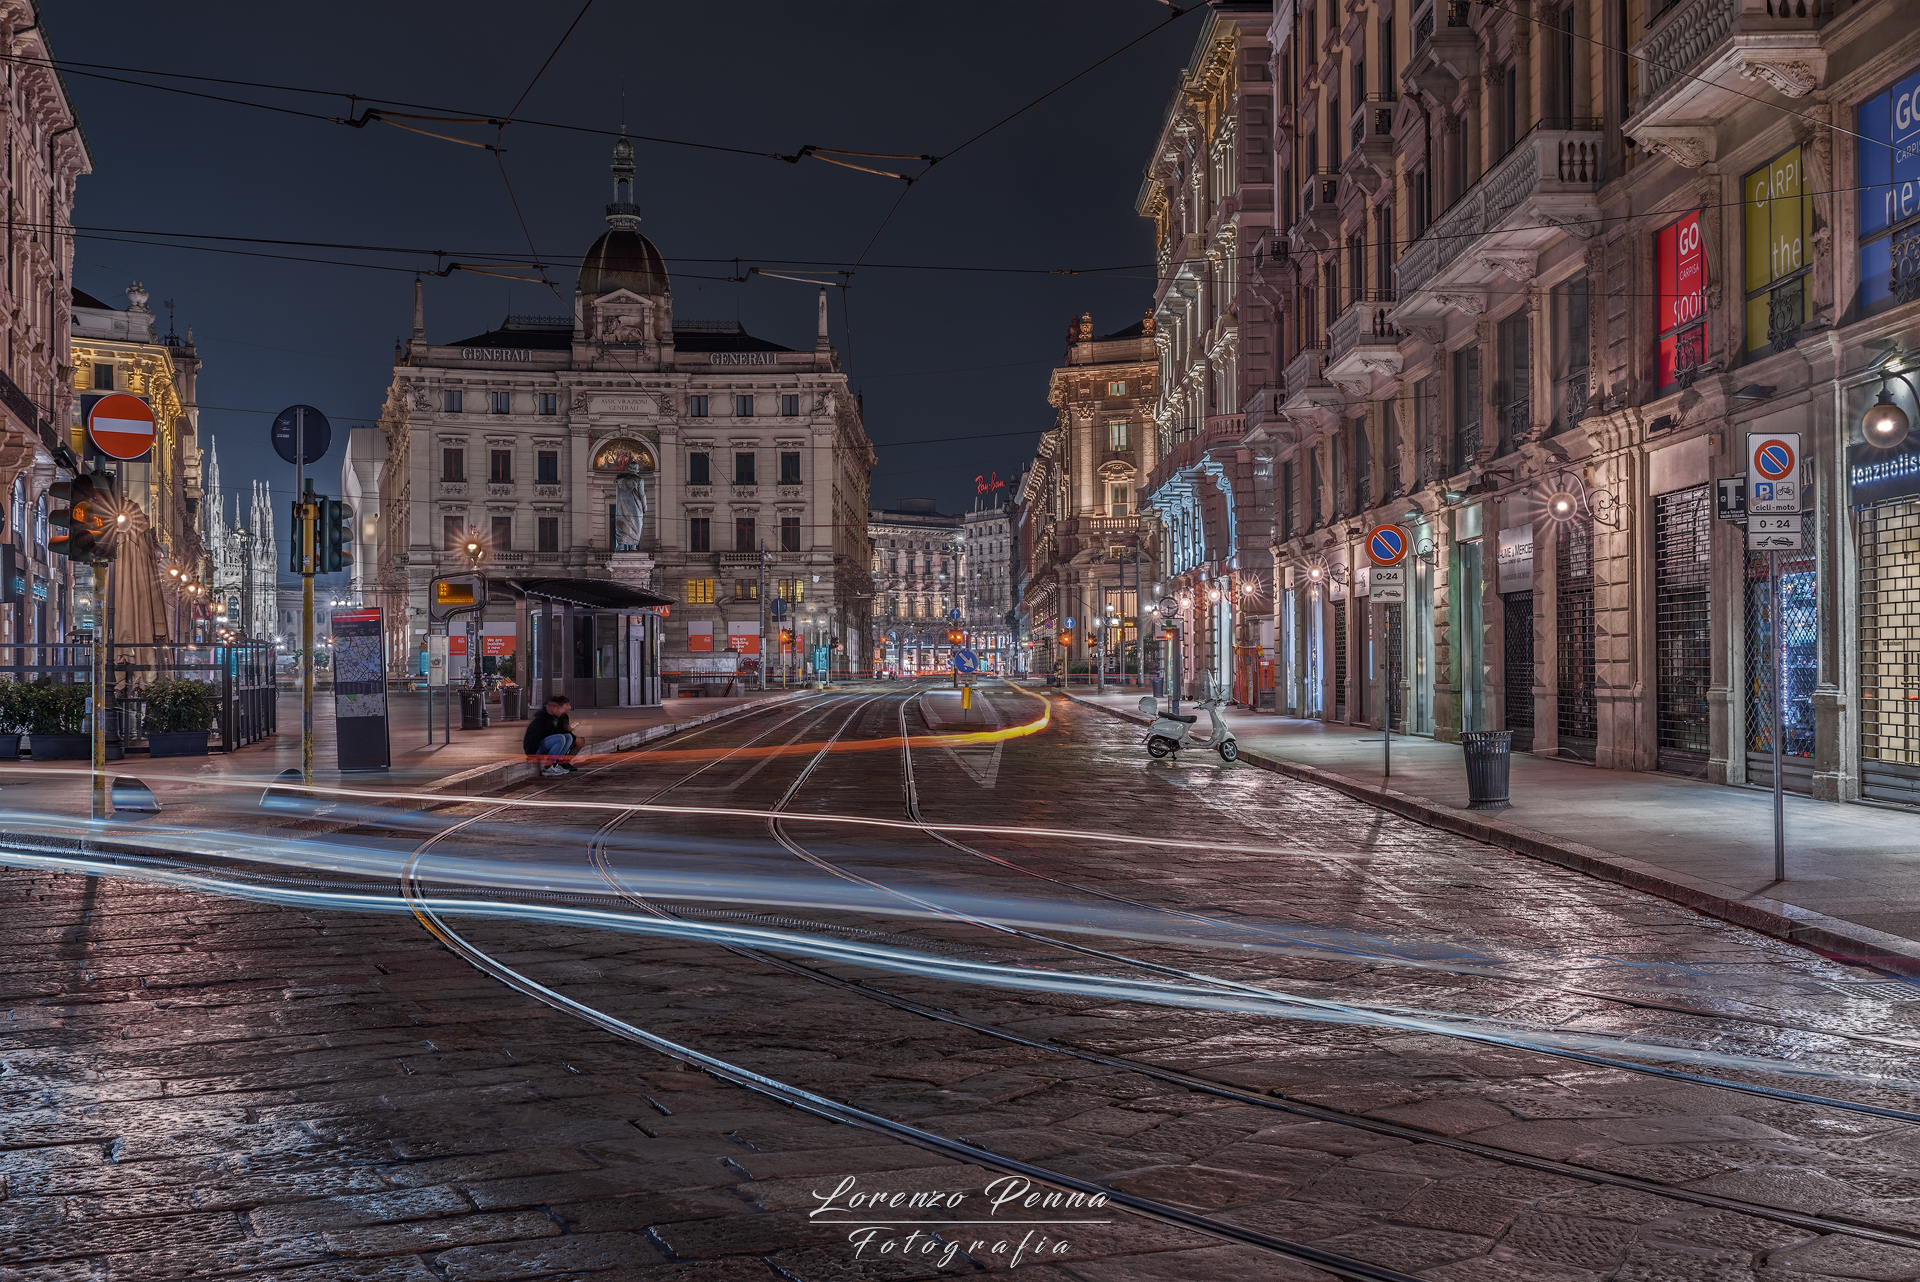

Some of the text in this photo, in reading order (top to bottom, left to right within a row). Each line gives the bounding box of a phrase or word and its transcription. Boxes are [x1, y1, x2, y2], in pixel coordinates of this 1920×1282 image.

[1896, 140, 1920, 164] CARPI
[1755, 159, 1807, 208] CARPI
[1679, 222, 1699, 256] GO
[1772, 235, 1801, 278] the
[1679, 262, 1700, 281] CARPISA
[462, 347, 532, 362] GENERALI
[709, 352, 777, 365] GENERALI
[1719, 478, 1744, 509] T
